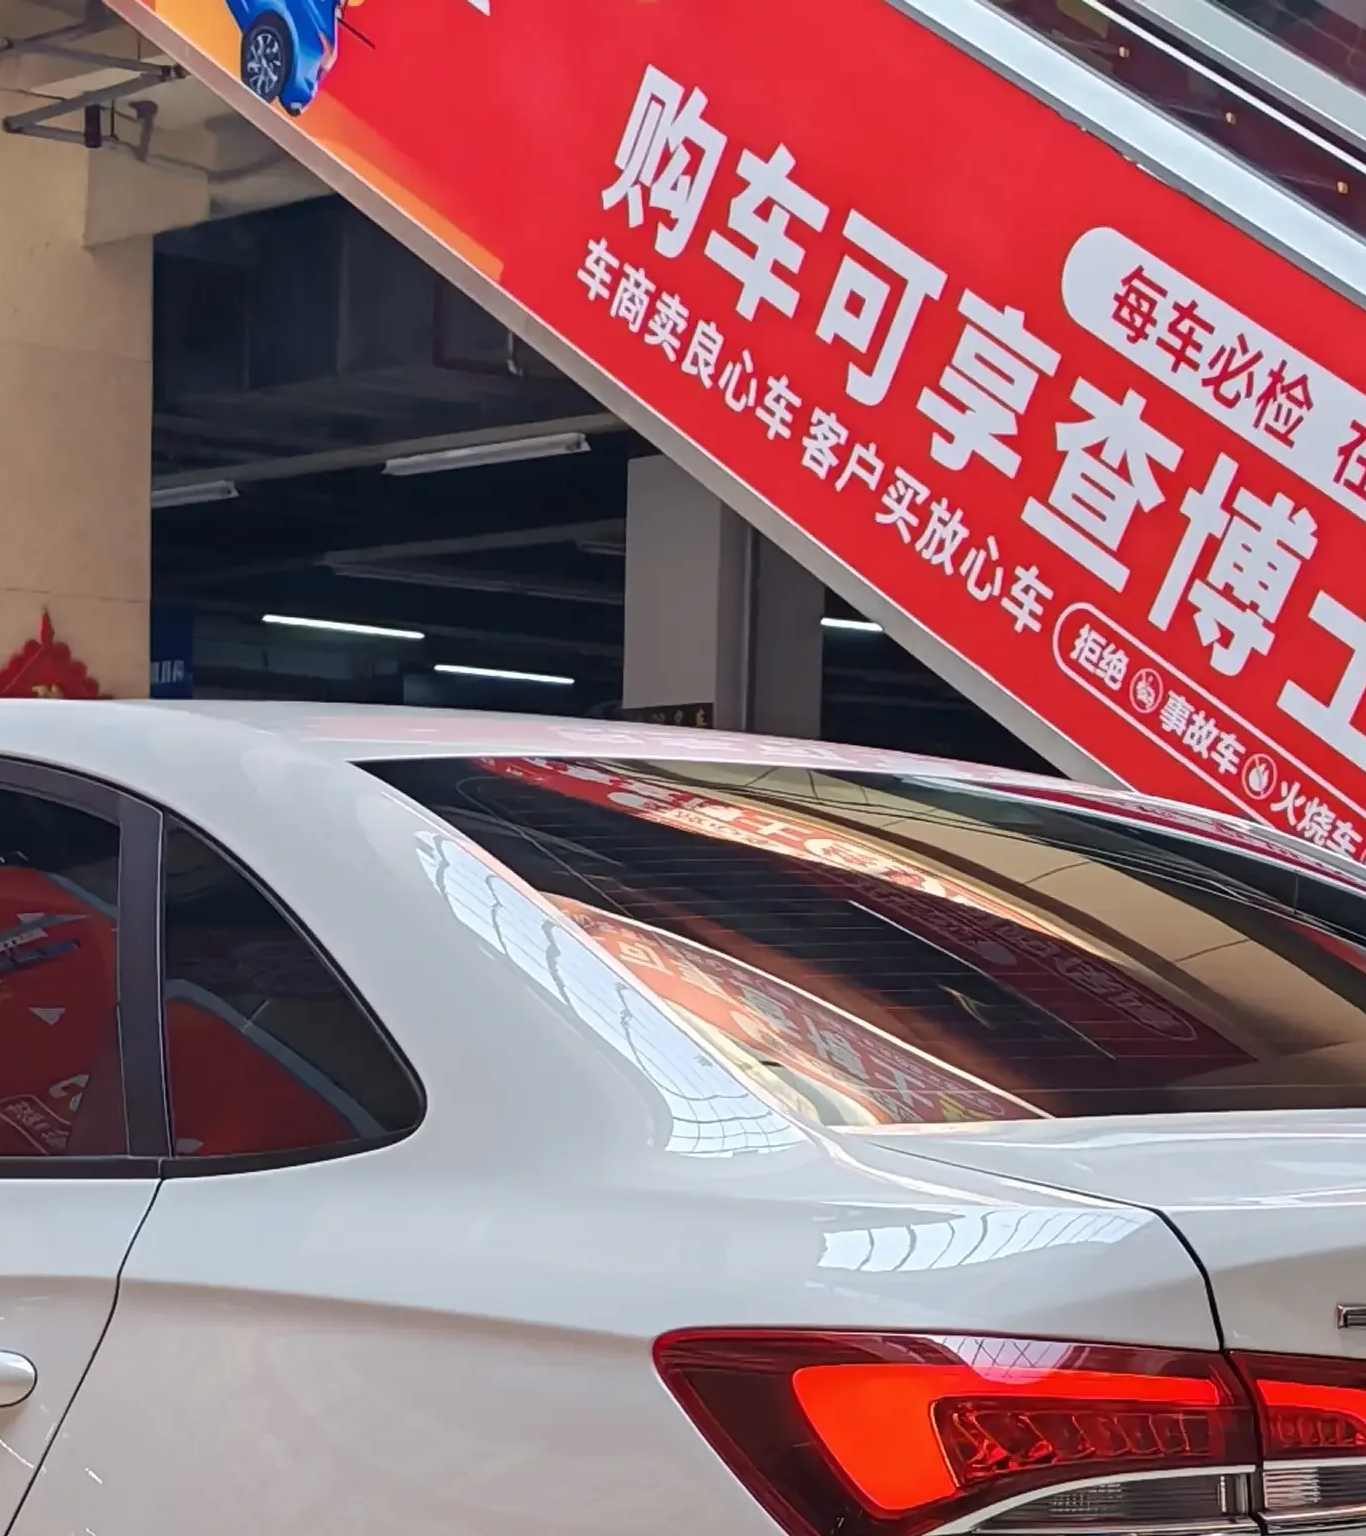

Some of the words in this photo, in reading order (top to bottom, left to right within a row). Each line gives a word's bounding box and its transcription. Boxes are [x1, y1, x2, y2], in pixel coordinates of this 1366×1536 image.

[576, 238, 802, 441] 车商卖良心车
[800, 413, 1054, 634] 客户买放心车
[1109, 264, 1315, 448] 每车必检
[1069, 622, 1130, 691] 拒绝
[1158, 690, 1247, 776] 事故车
[1270, 779, 1363, 858] 火烧车
